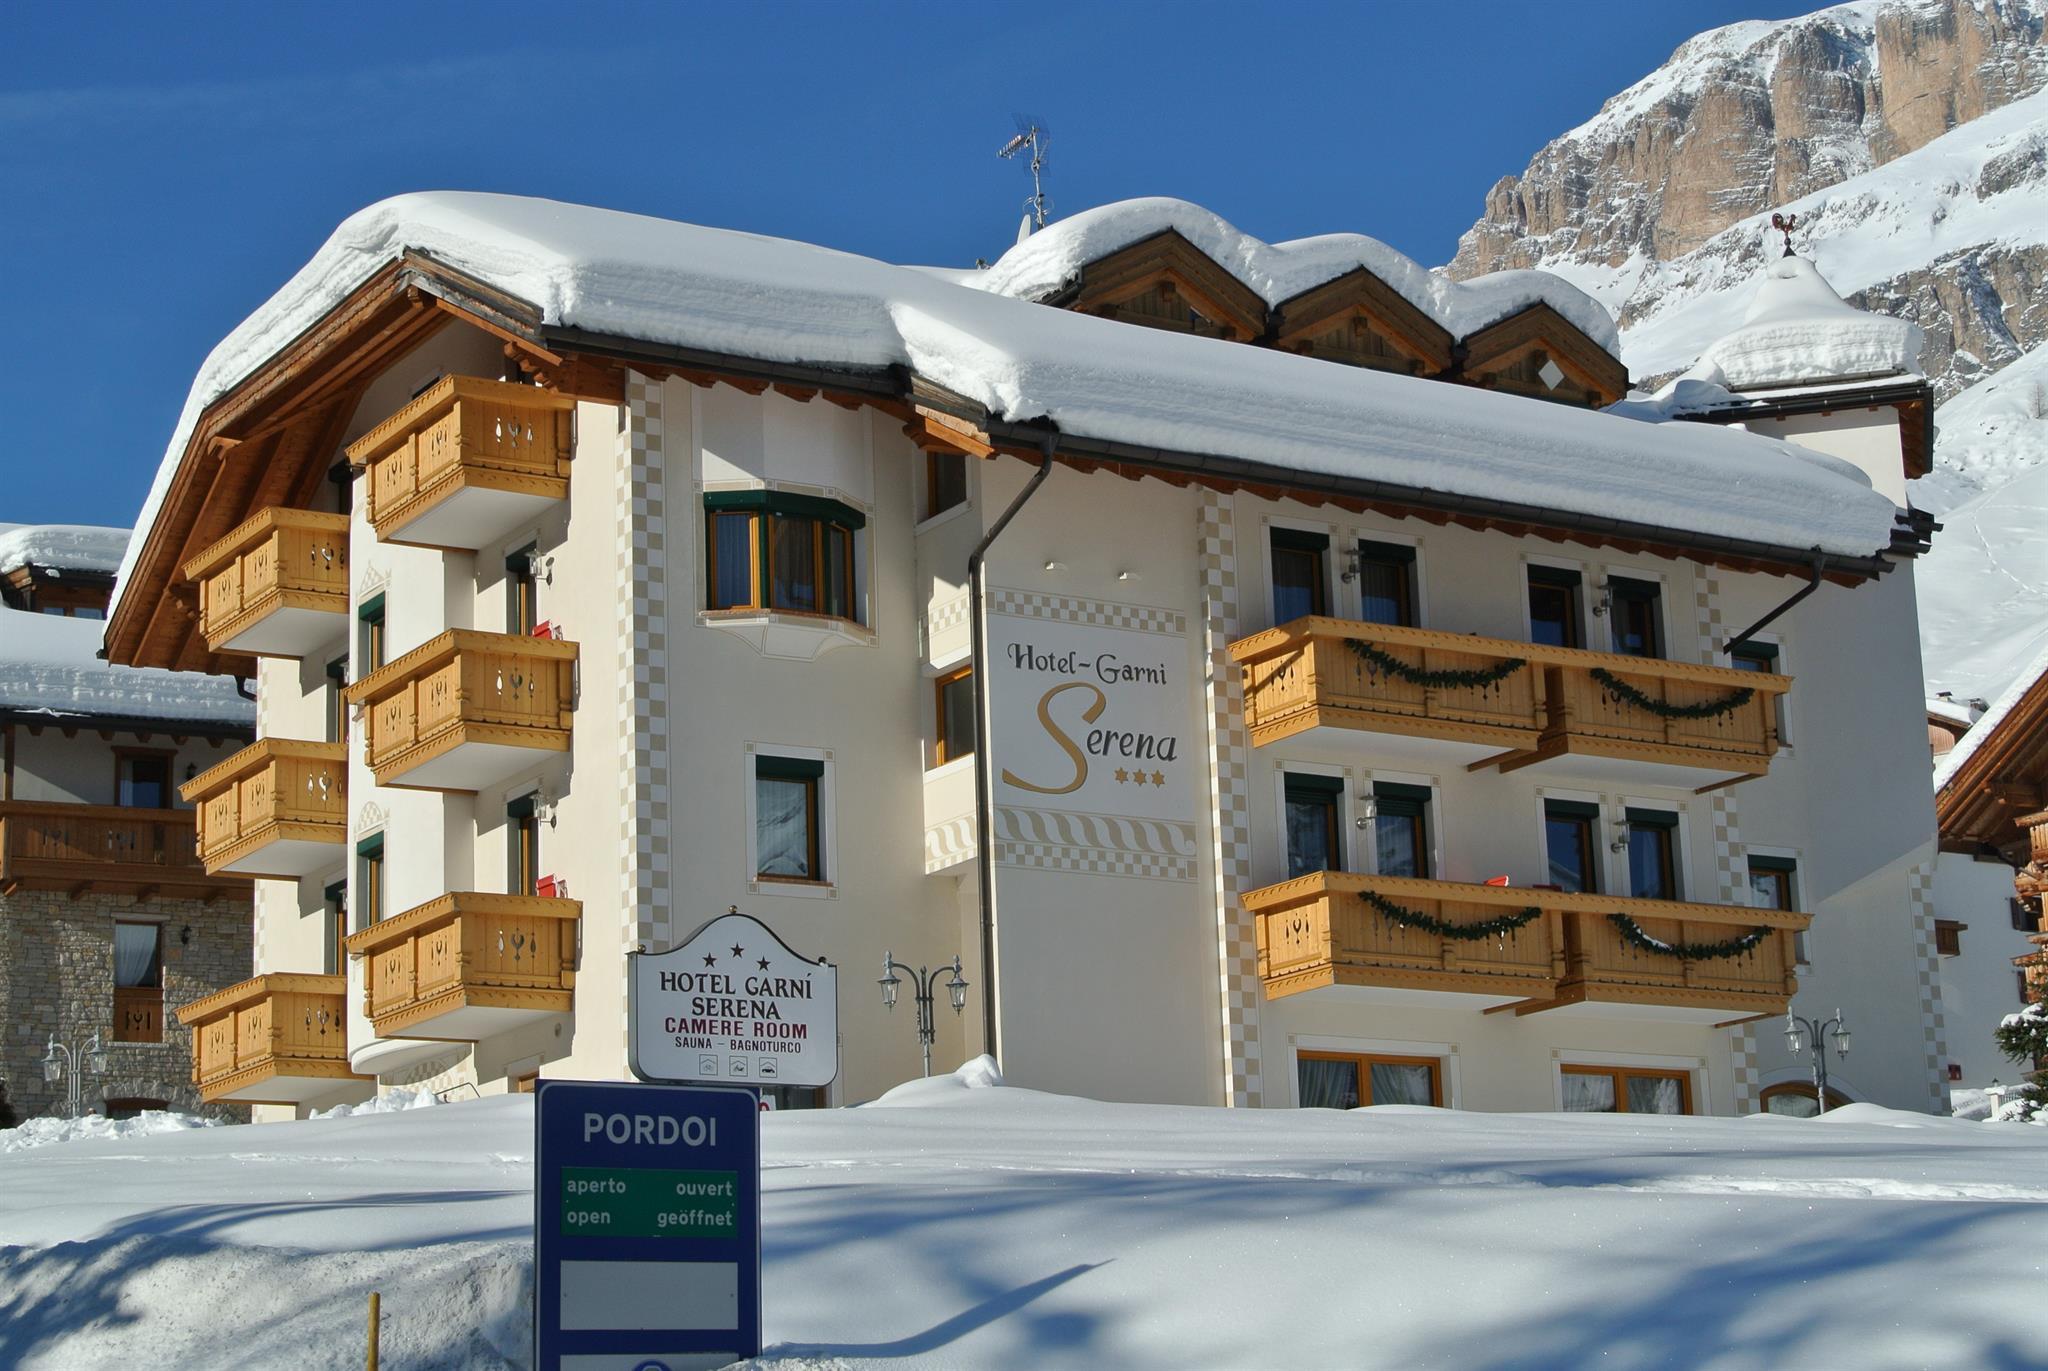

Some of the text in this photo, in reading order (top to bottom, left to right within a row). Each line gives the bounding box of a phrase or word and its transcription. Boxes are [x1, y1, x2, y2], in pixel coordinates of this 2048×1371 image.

[1007, 643, 1167, 685] Hotel-Garni
[1002, 681, 1177, 794] Serena
[659, 971, 736, 995] HOTEL
[691, 996, 781, 1020] SERENA
[665, 1017, 808, 1040] CAMERE ROOM
[675, 1036, 713, 1049] SAUNA
[730, 1039, 801, 1054] BAGNOTURCO
[584, 1113, 717, 1147] PORDOI
[567, 1177, 733, 1197] aperto ouvert
[567, 1209, 733, 1228] open geöffnet
